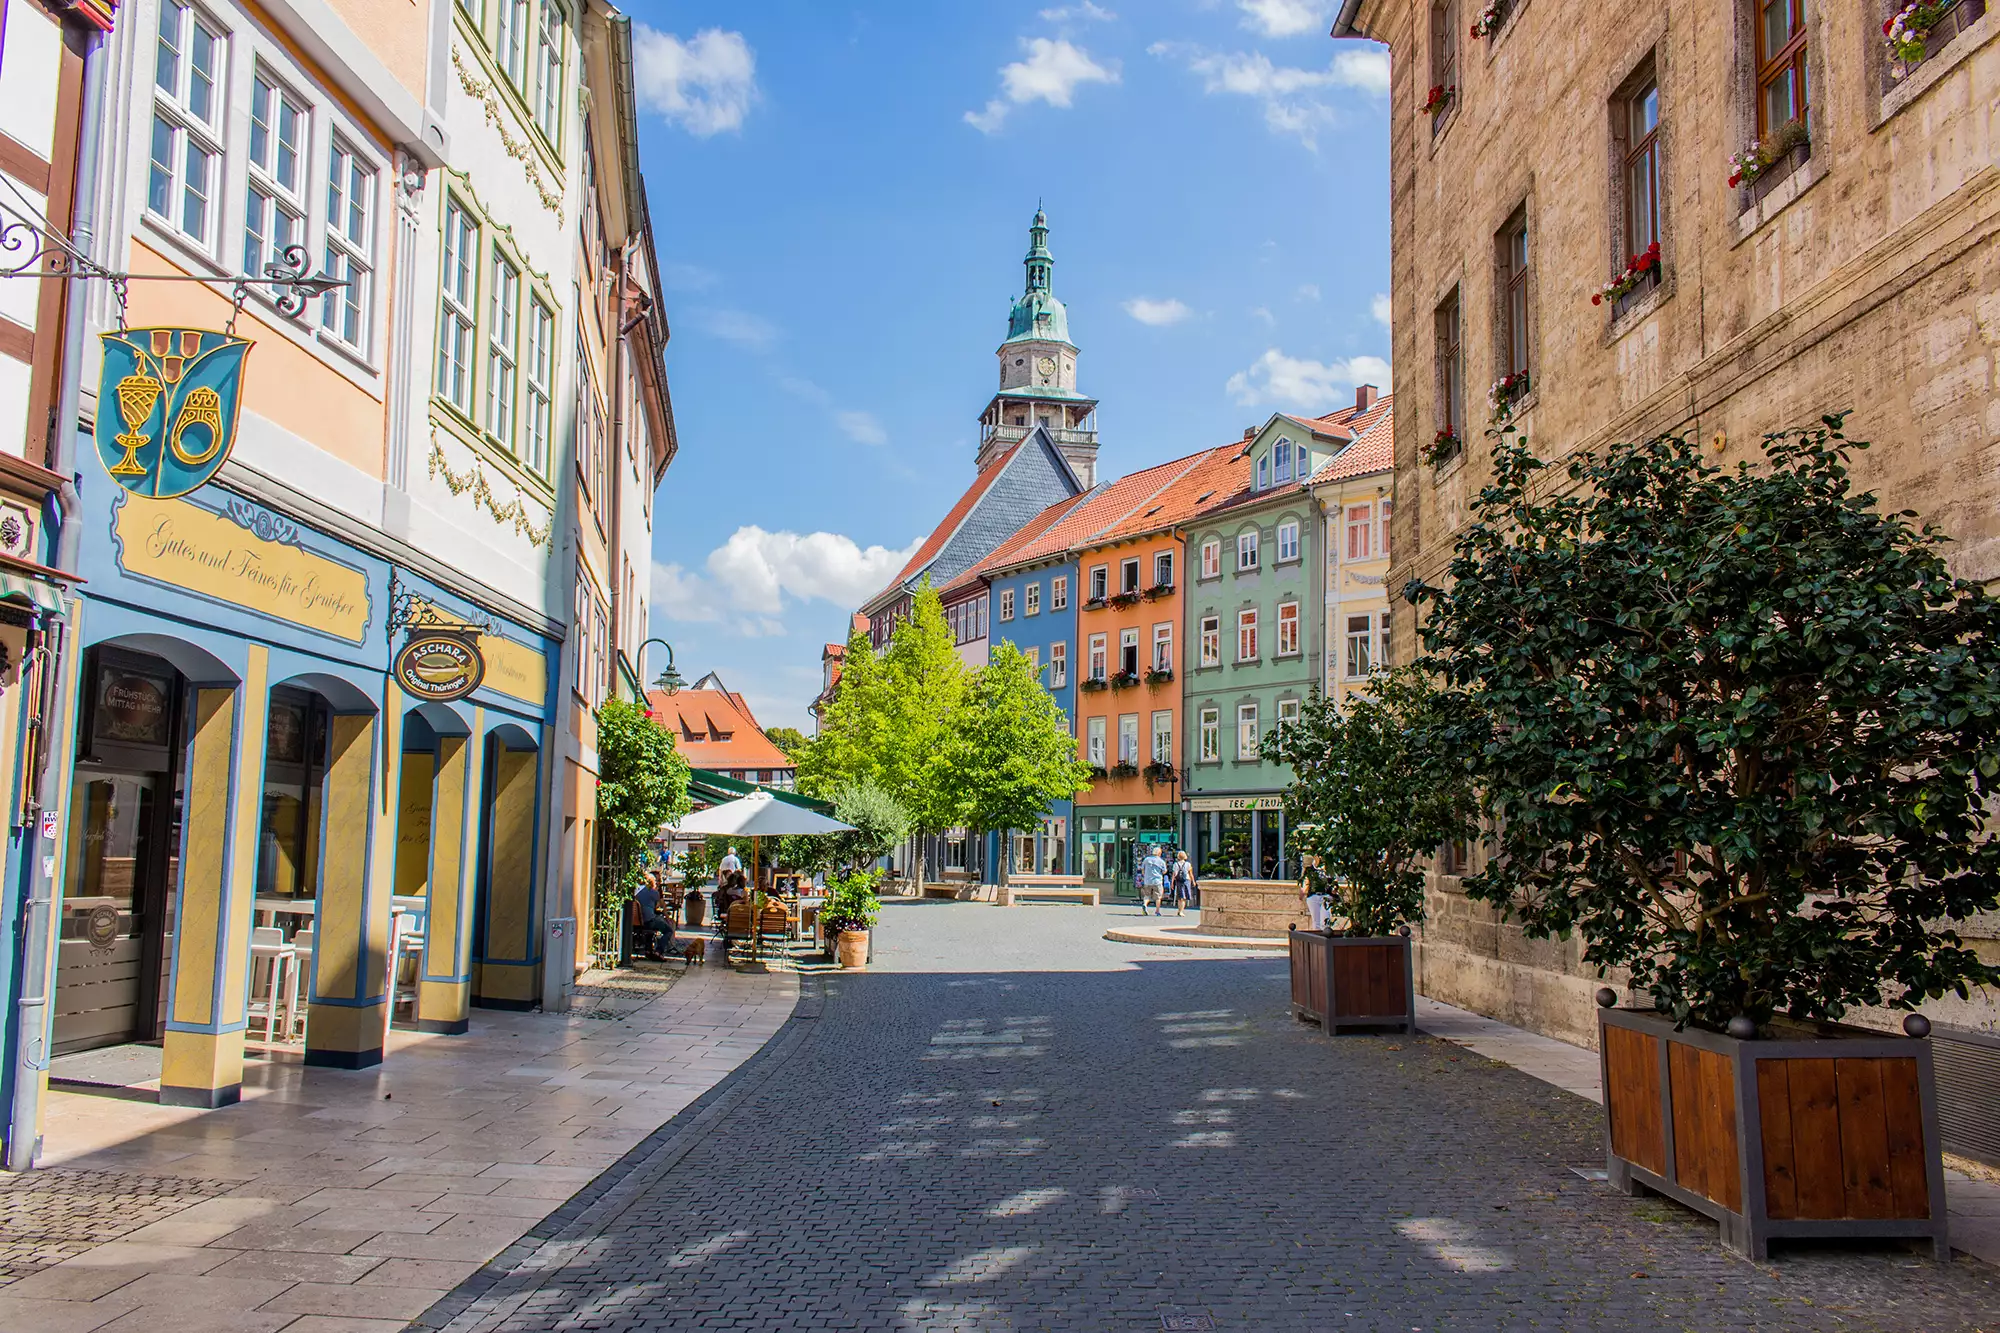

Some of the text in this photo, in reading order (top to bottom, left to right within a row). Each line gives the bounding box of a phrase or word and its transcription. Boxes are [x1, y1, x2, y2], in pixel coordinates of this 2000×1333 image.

[146, 513, 196, 562] Gutes
[198, 550, 232, 571] und
[232, 549, 279, 590] Feines
[273, 571, 298, 600] für
[412, 643, 467, 664] ASCHARA
[405, 668, 465, 692] Original Thüringer
[107, 695, 136, 710] MITTAG
[141, 703, 162, 714] MEHR
[1228, 799, 1245, 809] TEE
